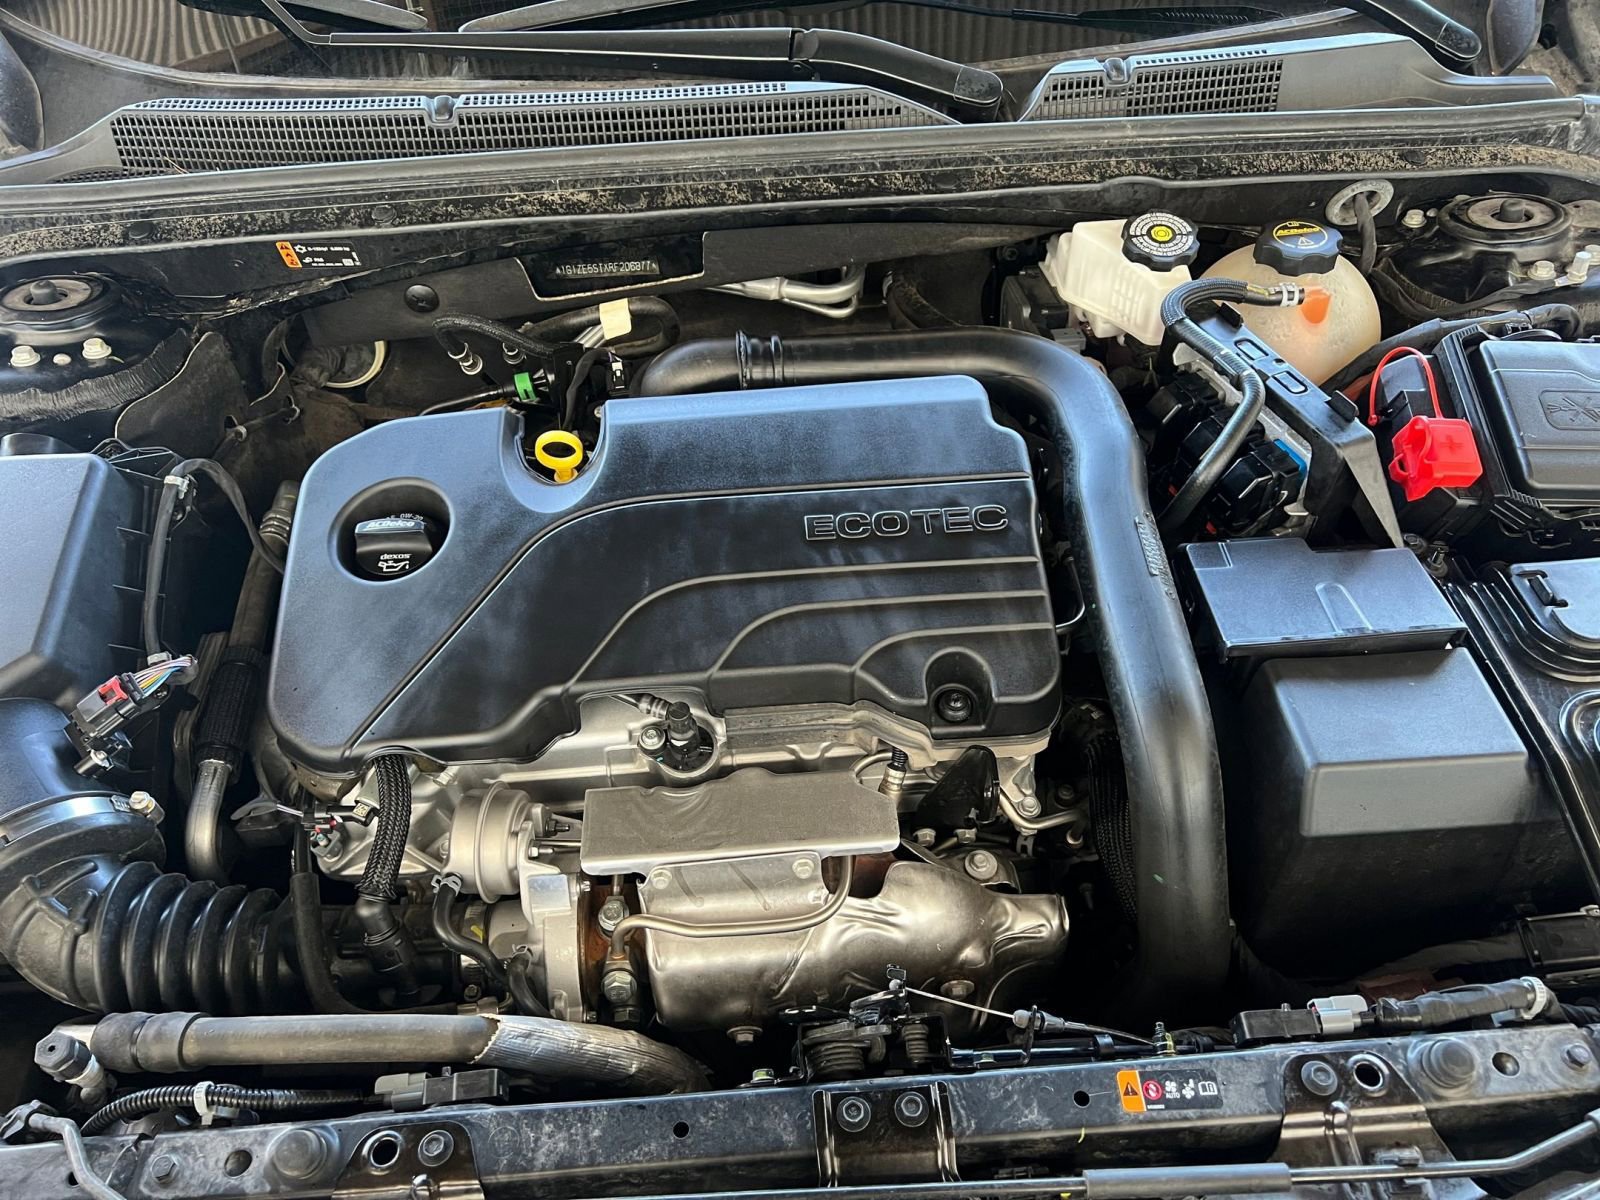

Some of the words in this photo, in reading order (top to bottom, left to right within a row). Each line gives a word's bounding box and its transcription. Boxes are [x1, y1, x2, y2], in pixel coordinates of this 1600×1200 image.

[803, 504, 1009, 541] ECOTEC
[380, 553, 412, 561] dexos
[1165, 1091, 1181, 1099] AUTO
